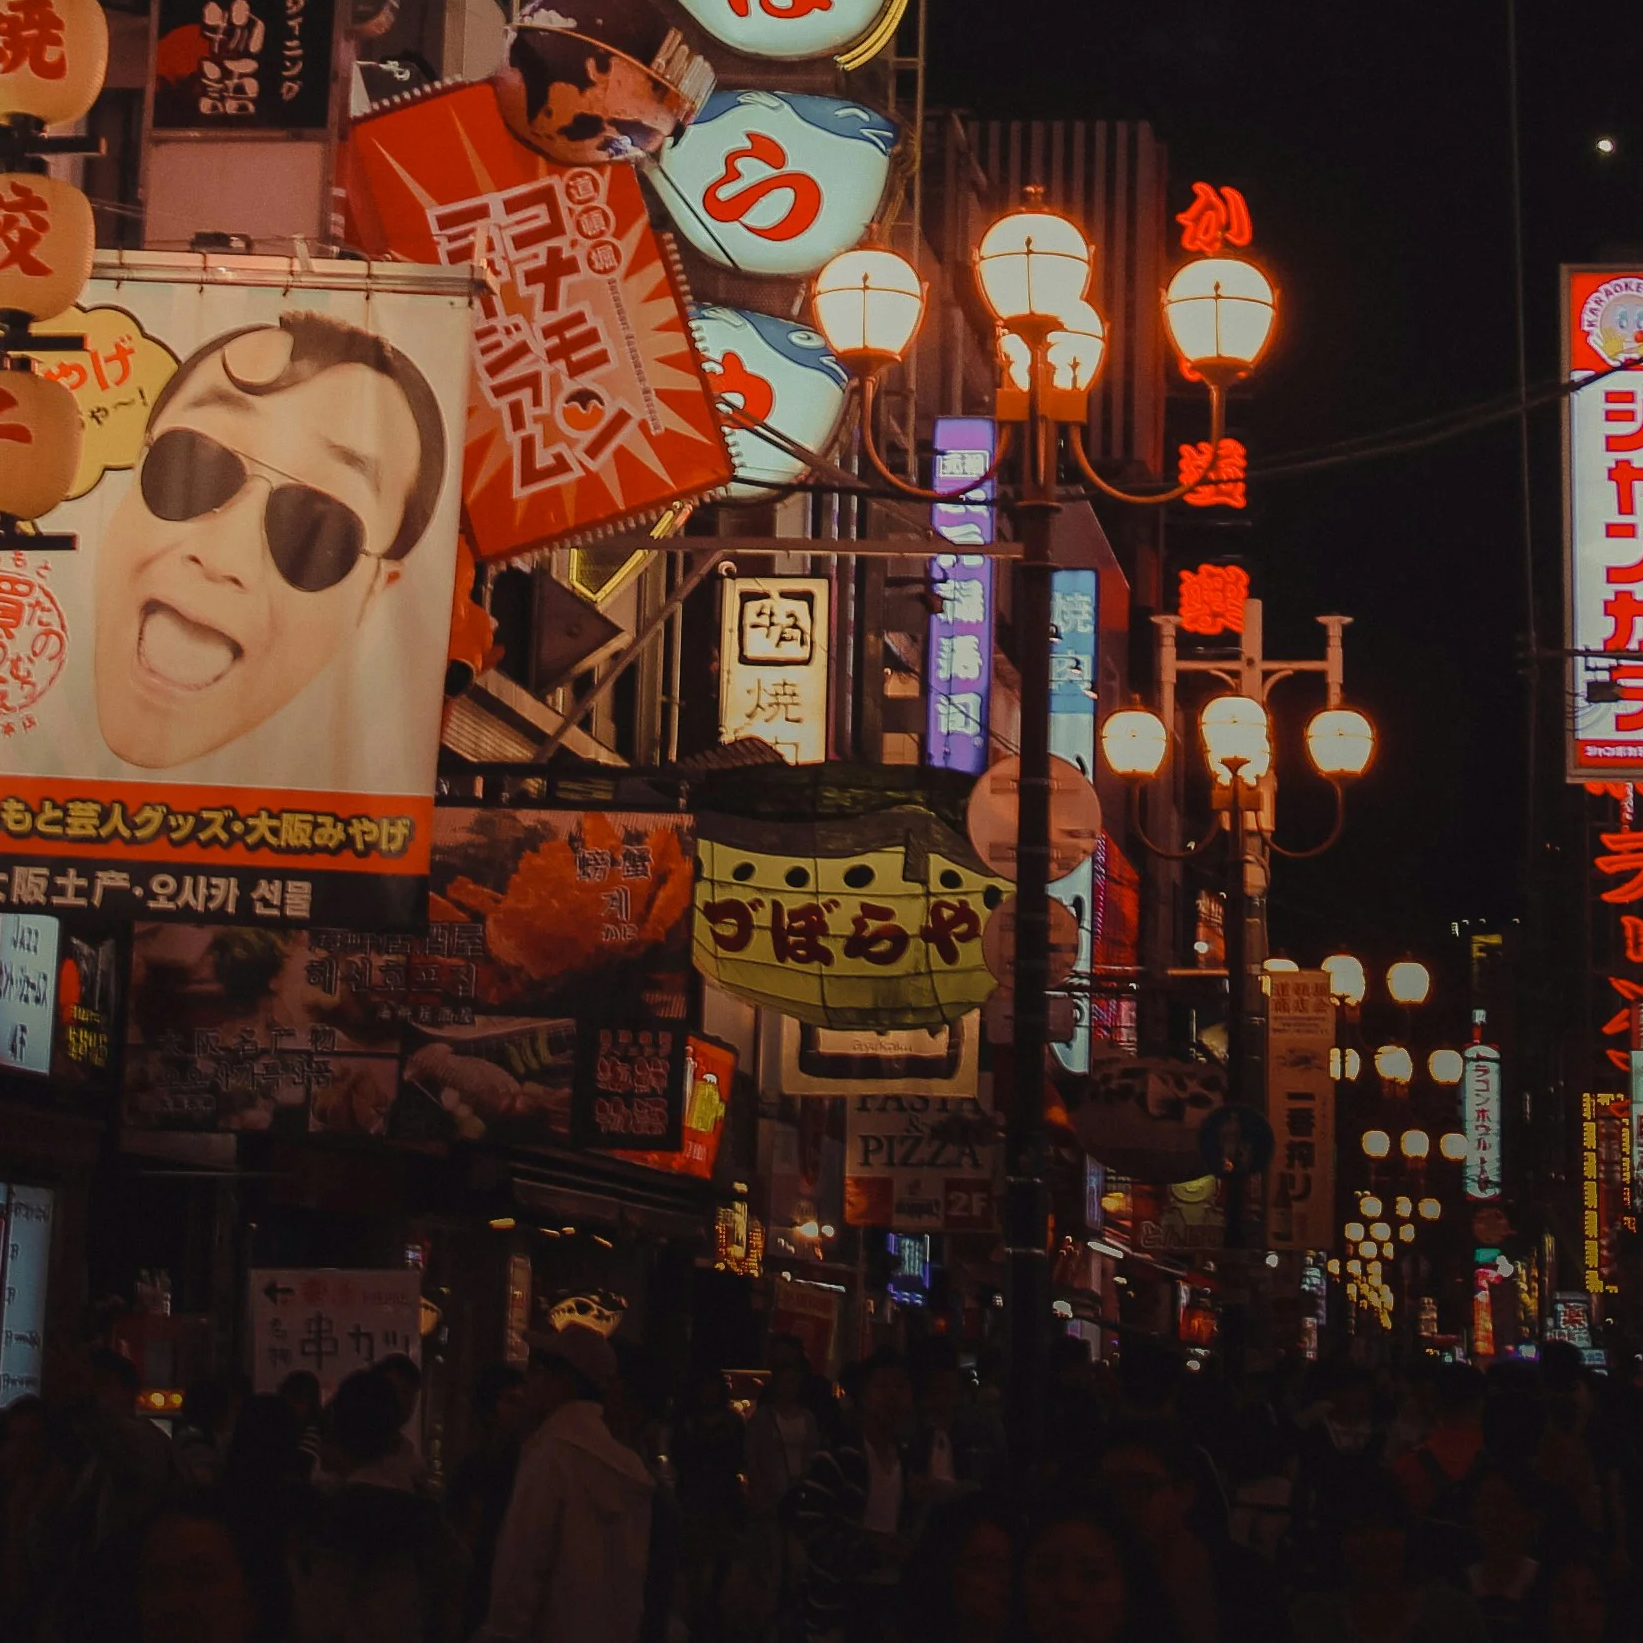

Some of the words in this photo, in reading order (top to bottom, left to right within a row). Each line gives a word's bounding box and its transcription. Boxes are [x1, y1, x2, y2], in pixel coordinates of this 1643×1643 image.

[749, 607, 808, 649] 牛角
[1051, 591, 1095, 694] 焼肉
[251, 877, 314, 920] 선물
[702, 896, 982, 966] づぼらや
[862, 1134, 981, 1168] PIZZA
[947, 1189, 990, 1219] 2F
